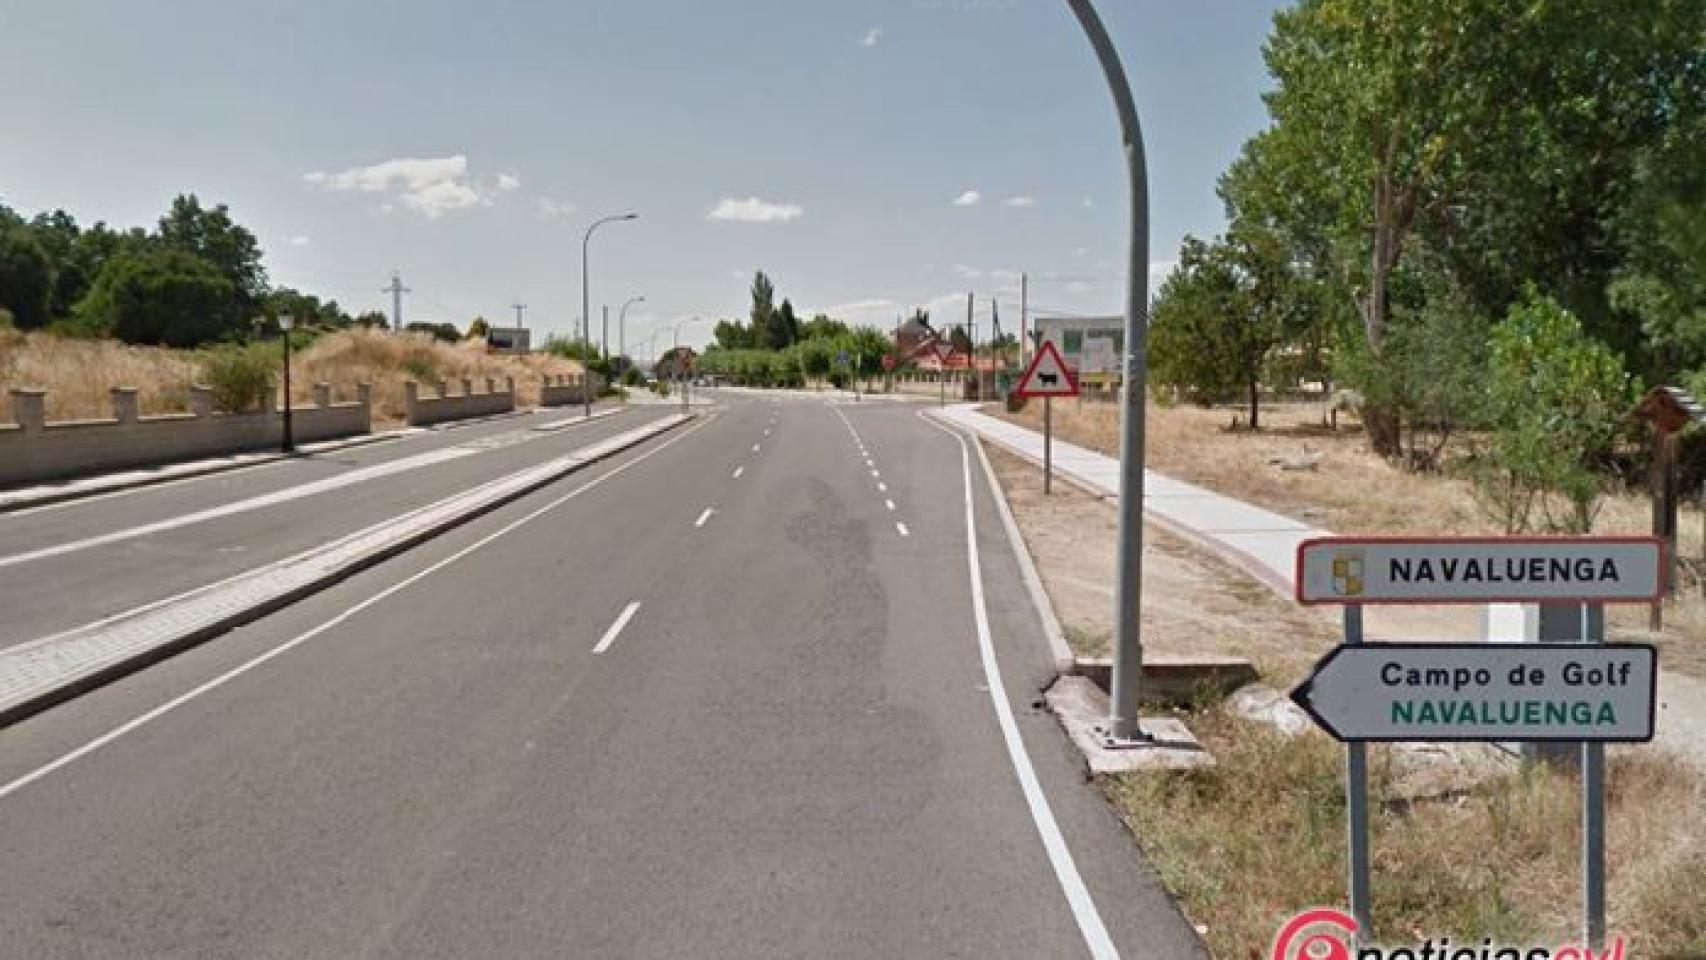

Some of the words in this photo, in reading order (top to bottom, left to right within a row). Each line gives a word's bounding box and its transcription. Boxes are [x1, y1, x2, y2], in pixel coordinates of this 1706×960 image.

[1390, 557, 1619, 582] NAVALUENGA
[1380, 662, 1492, 691] Campo
[1508, 663, 1546, 686] de
[1563, 662, 1631, 686] Golf
[1391, 701, 1616, 725] NAVALUENGA
